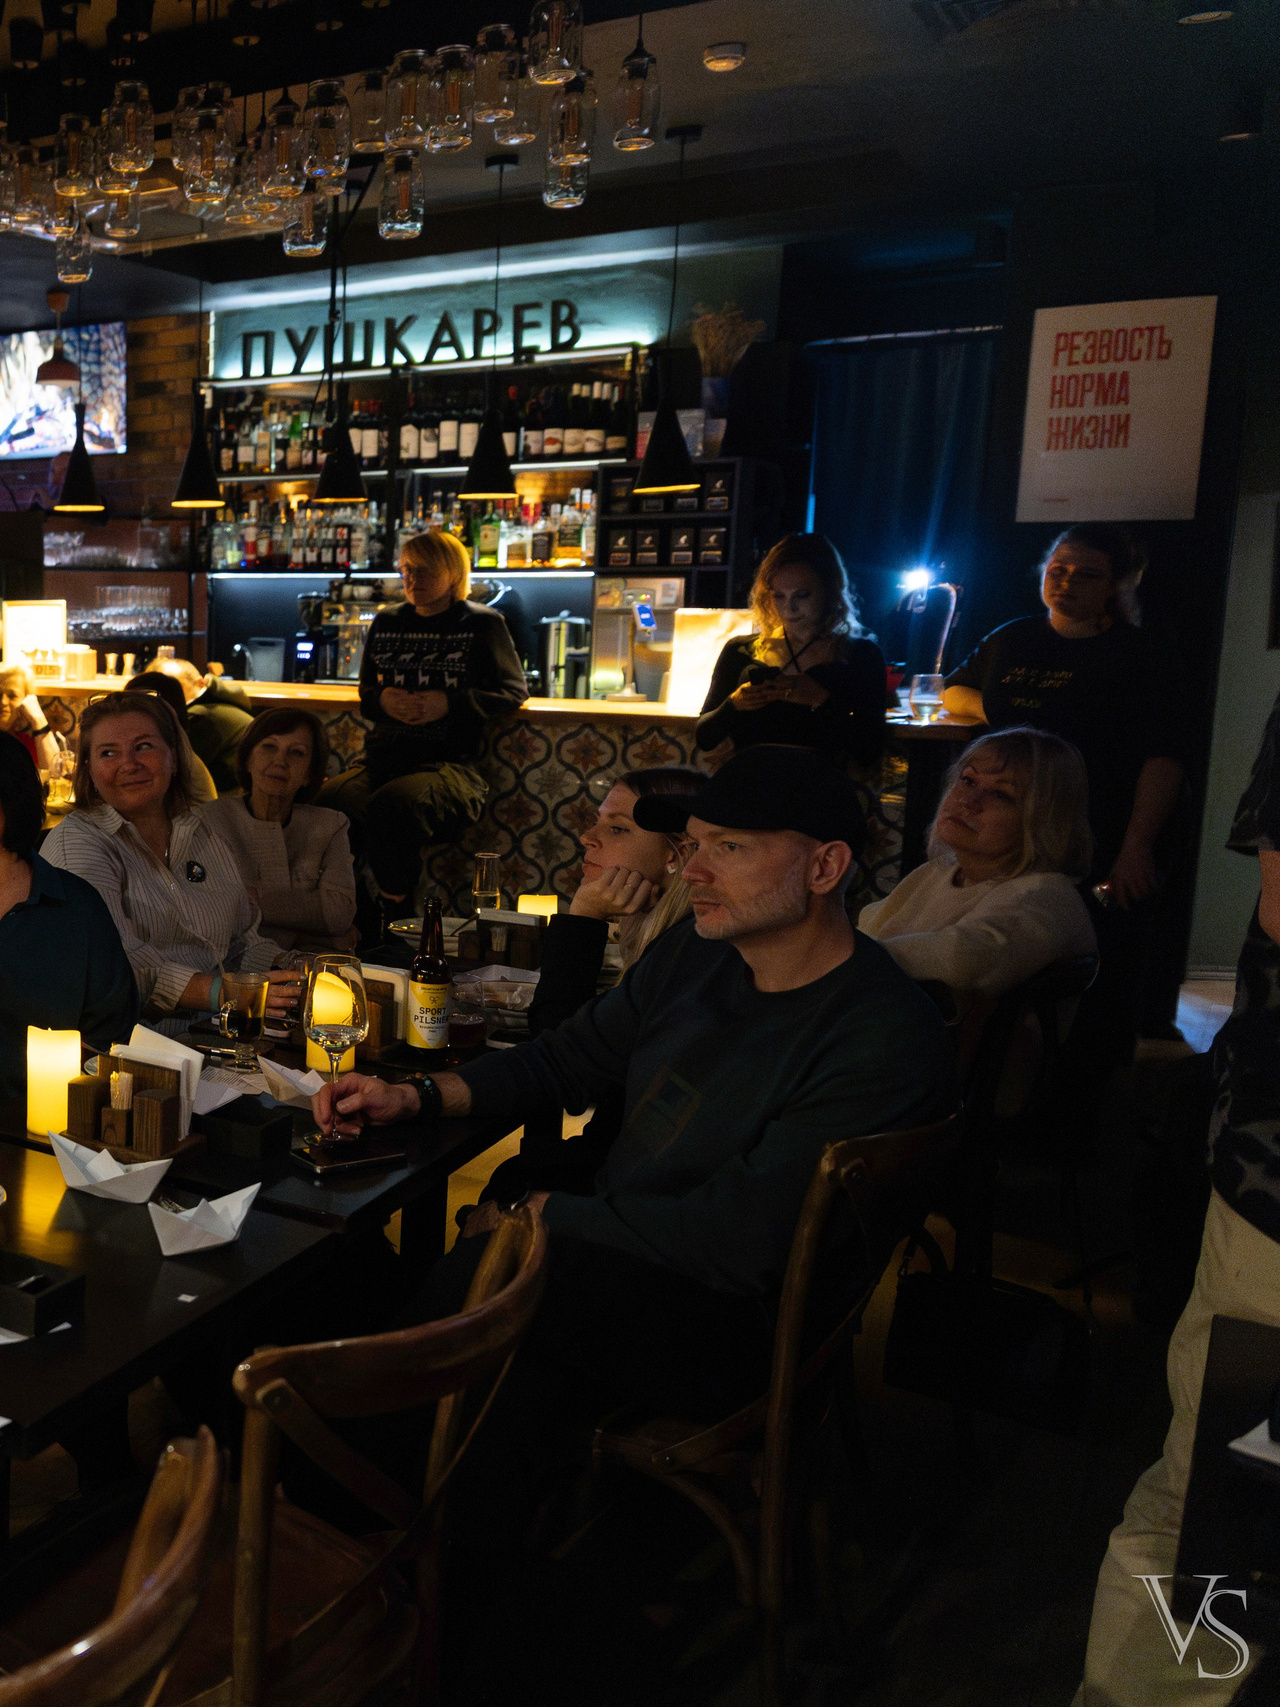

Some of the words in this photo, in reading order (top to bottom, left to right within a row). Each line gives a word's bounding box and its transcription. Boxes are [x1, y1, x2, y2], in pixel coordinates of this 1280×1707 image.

[242, 300, 582, 378] ПУШКАРЕВ
[1053, 325, 1172, 367] РЕЗВОСТЬ
[1050, 370, 1131, 409] НОРМА
[1046, 412, 1131, 452] ЖИЗНИ
[419, 1006, 446, 1015] SPORT
